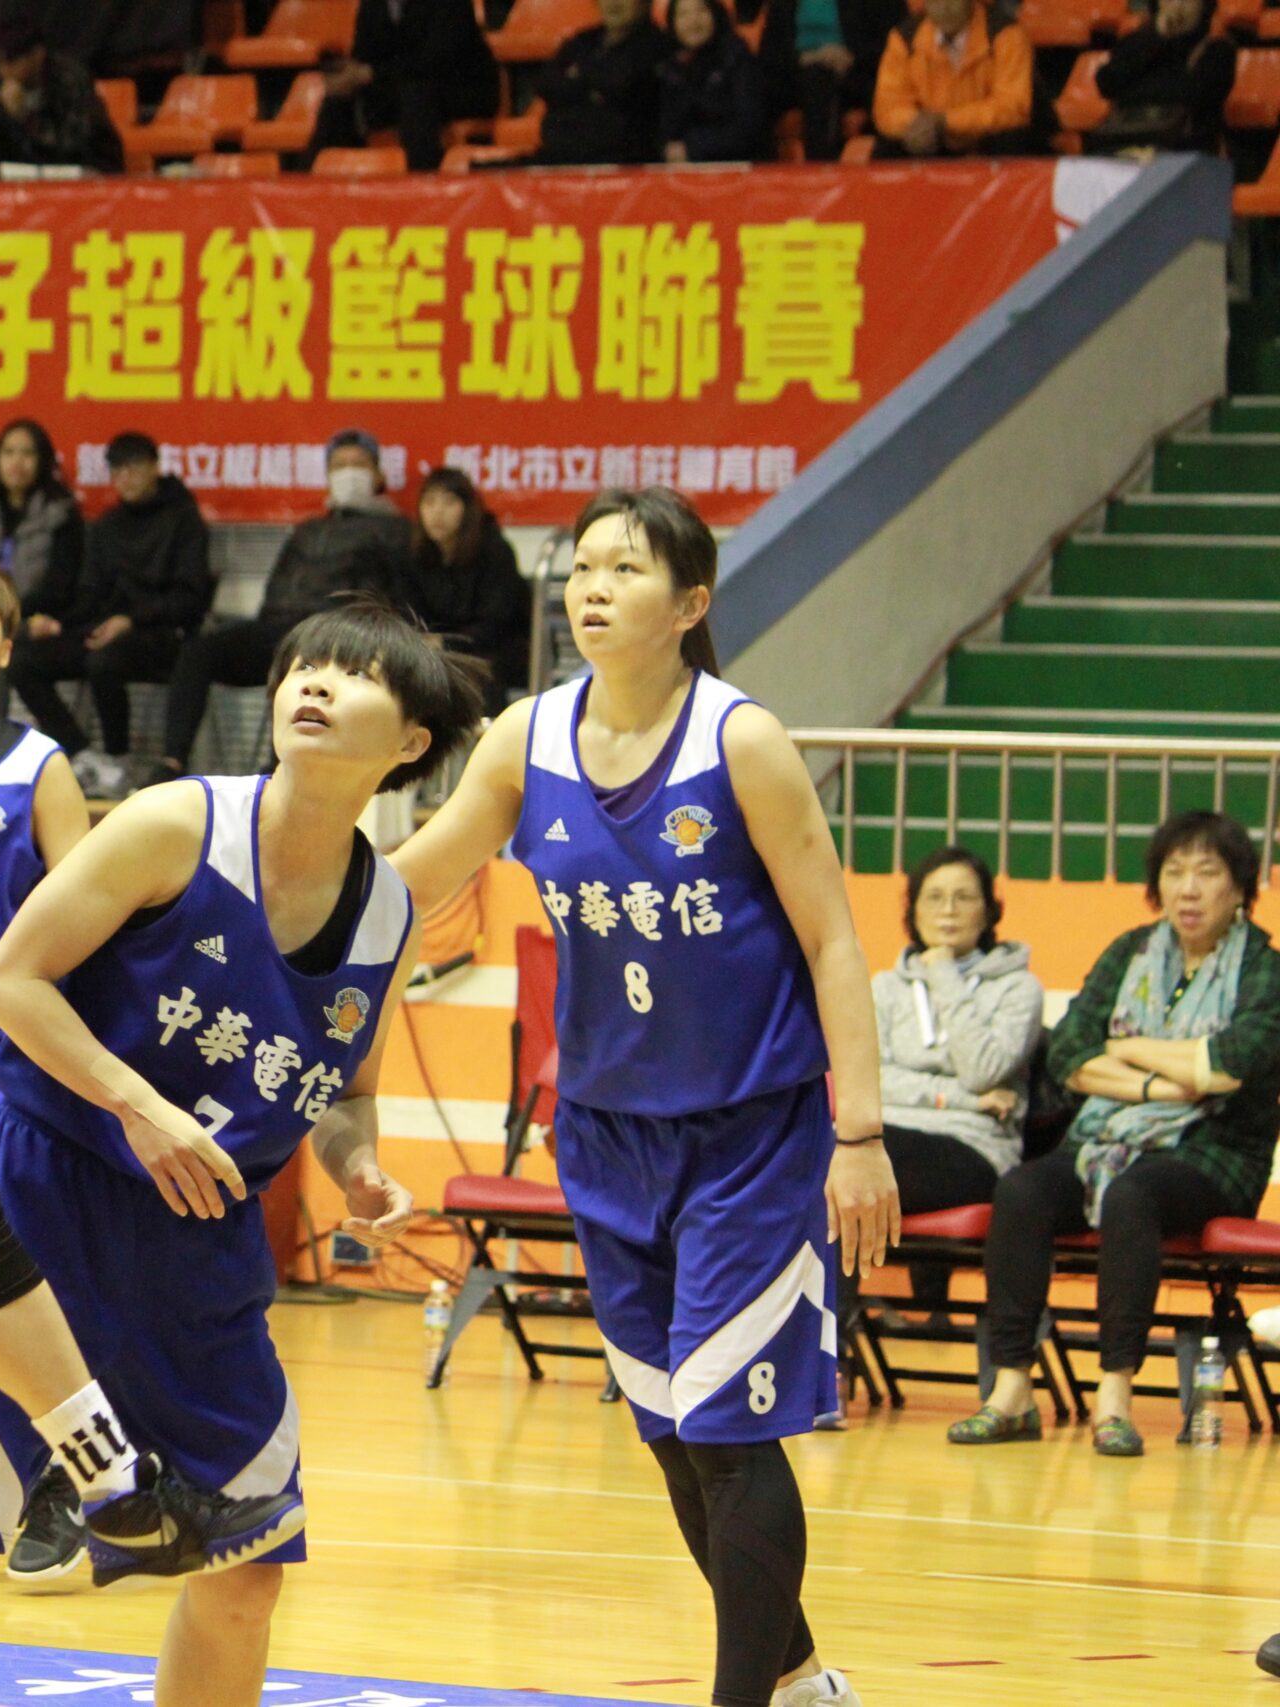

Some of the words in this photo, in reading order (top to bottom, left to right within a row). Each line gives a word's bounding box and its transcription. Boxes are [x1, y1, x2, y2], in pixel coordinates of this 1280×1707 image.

[541, 878, 724, 942] 中華電信
[193, 940, 229, 965] adidas
[624, 961, 654, 1014] 8
[157, 986, 344, 1124] 中華電信
[747, 1361, 777, 1415] 8
